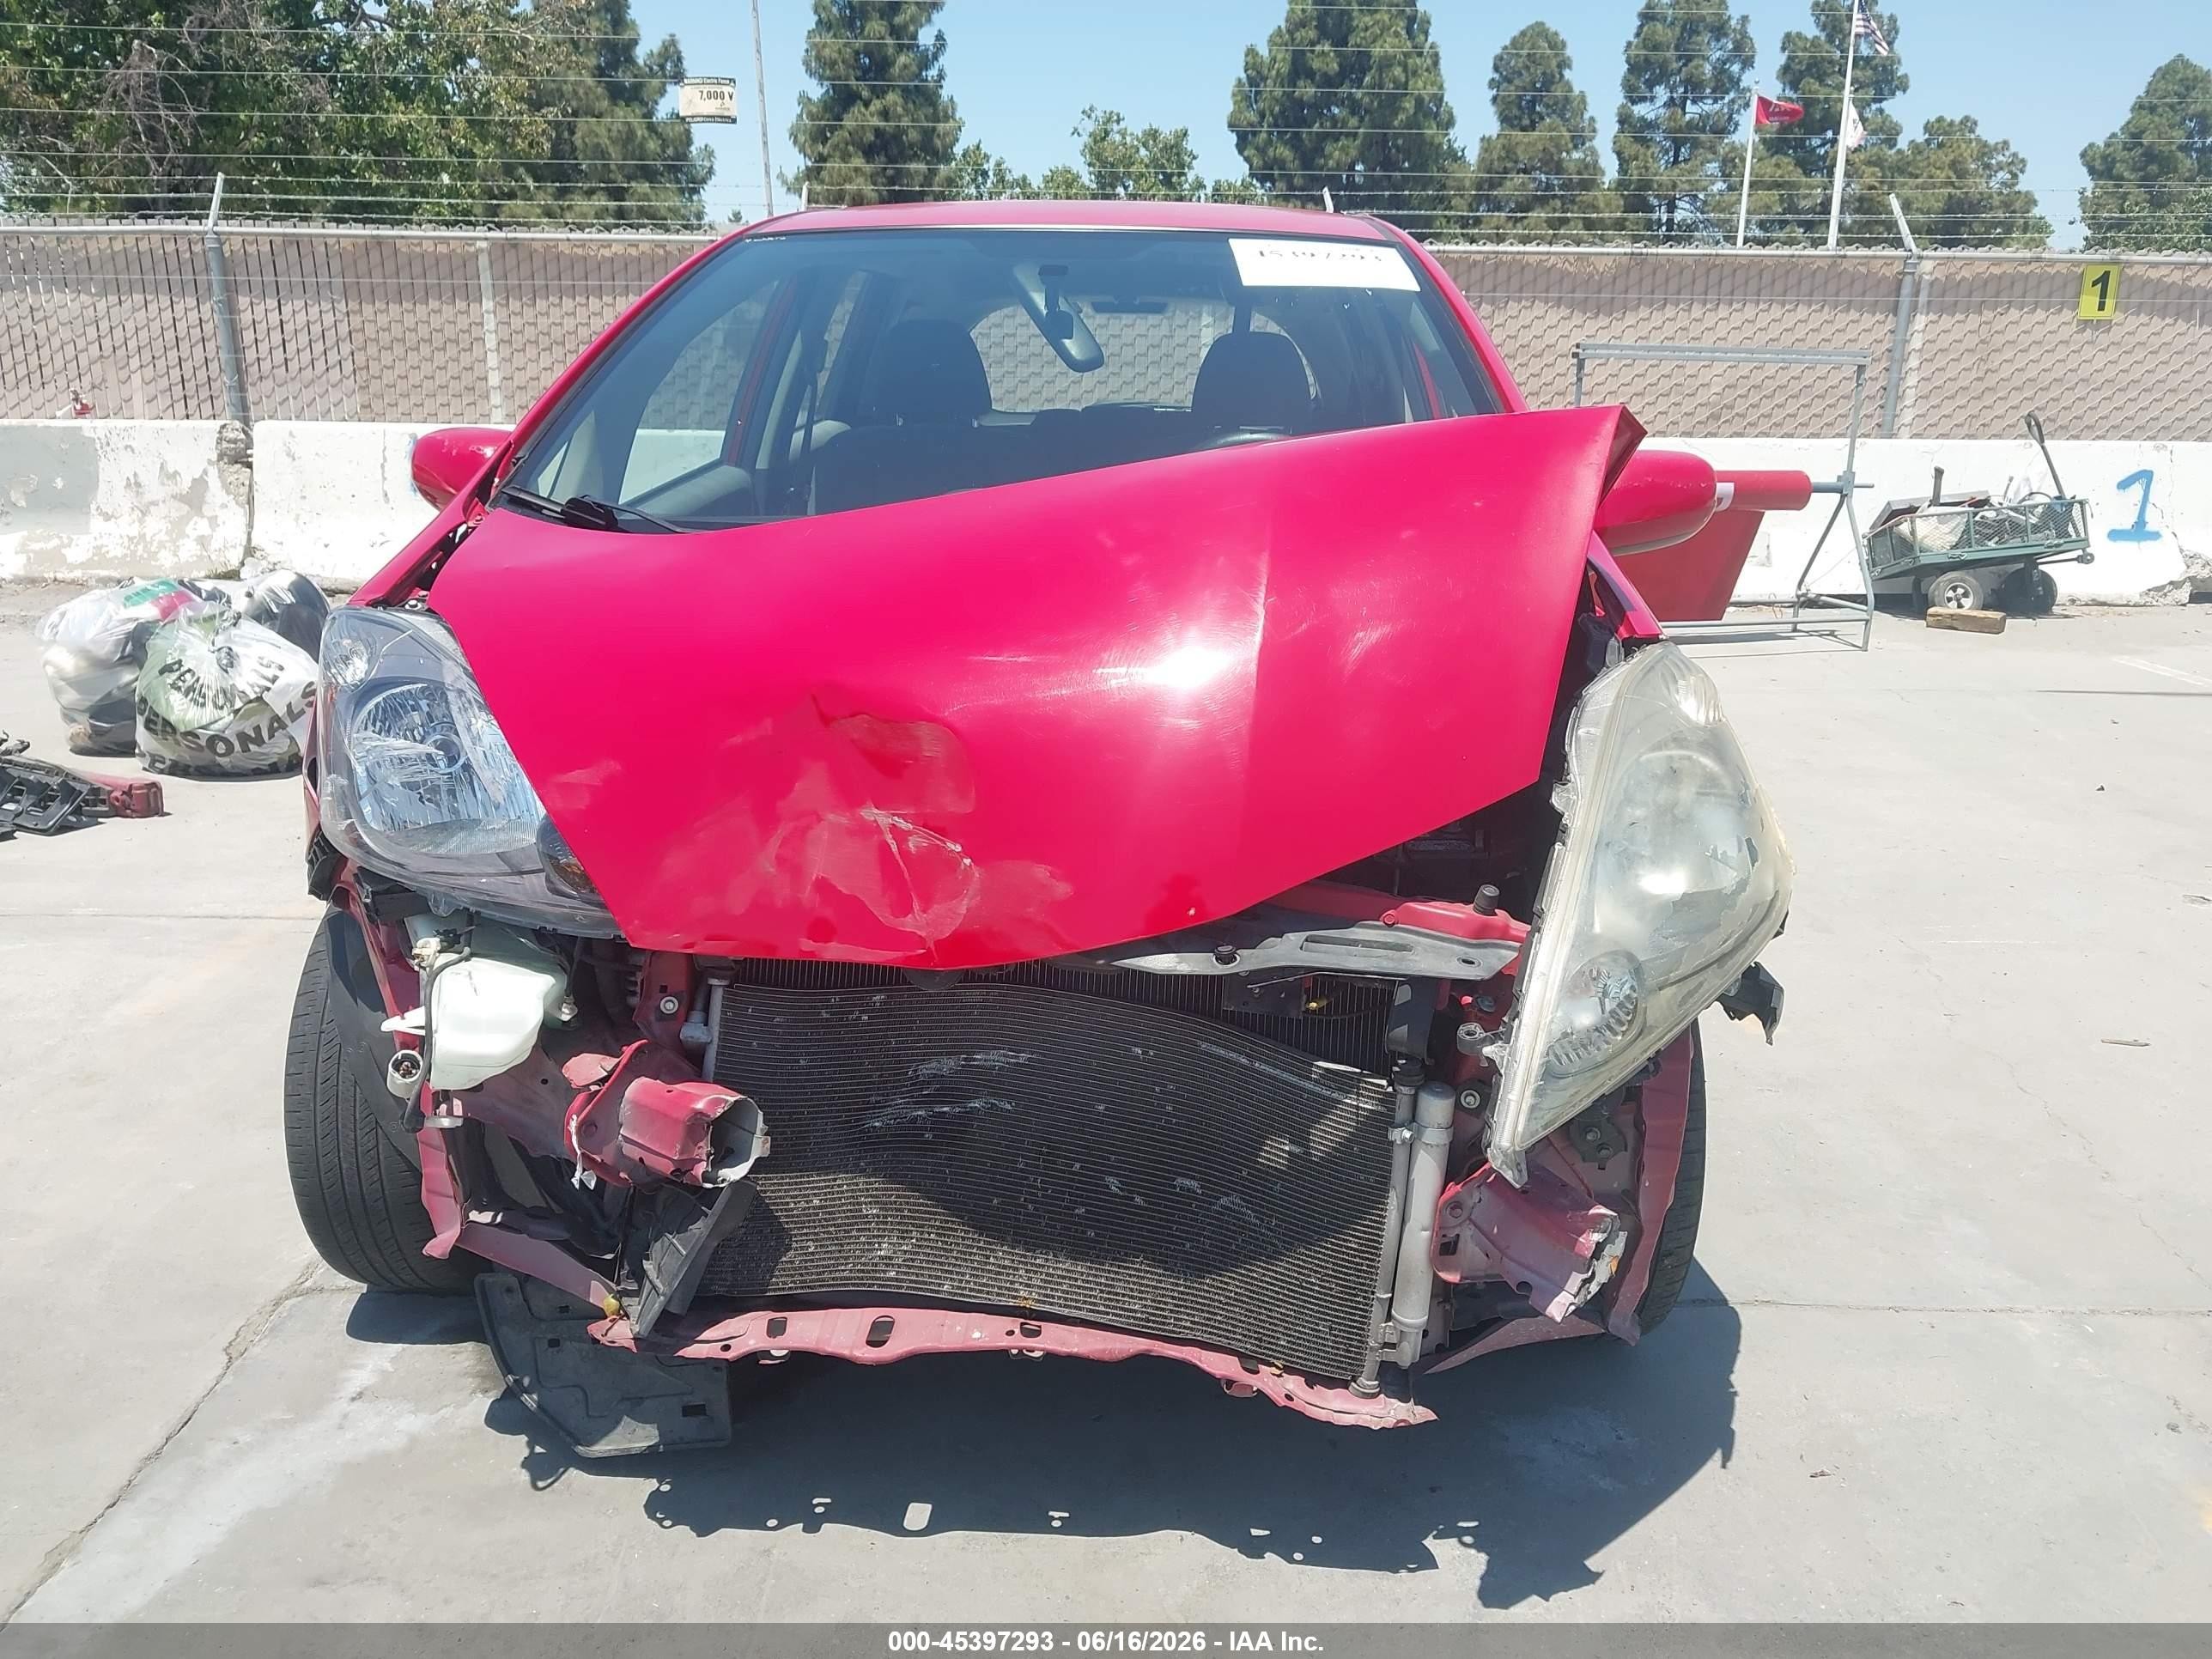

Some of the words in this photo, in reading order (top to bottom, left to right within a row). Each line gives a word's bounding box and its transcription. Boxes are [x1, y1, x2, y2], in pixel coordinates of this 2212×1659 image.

[698, 90, 725, 101] 7,000
[727, 91, 734, 101] V
[2091, 270, 2111, 312] 1
[2107, 469, 2163, 542] 1
[137, 680, 318, 757] PERSONALS
